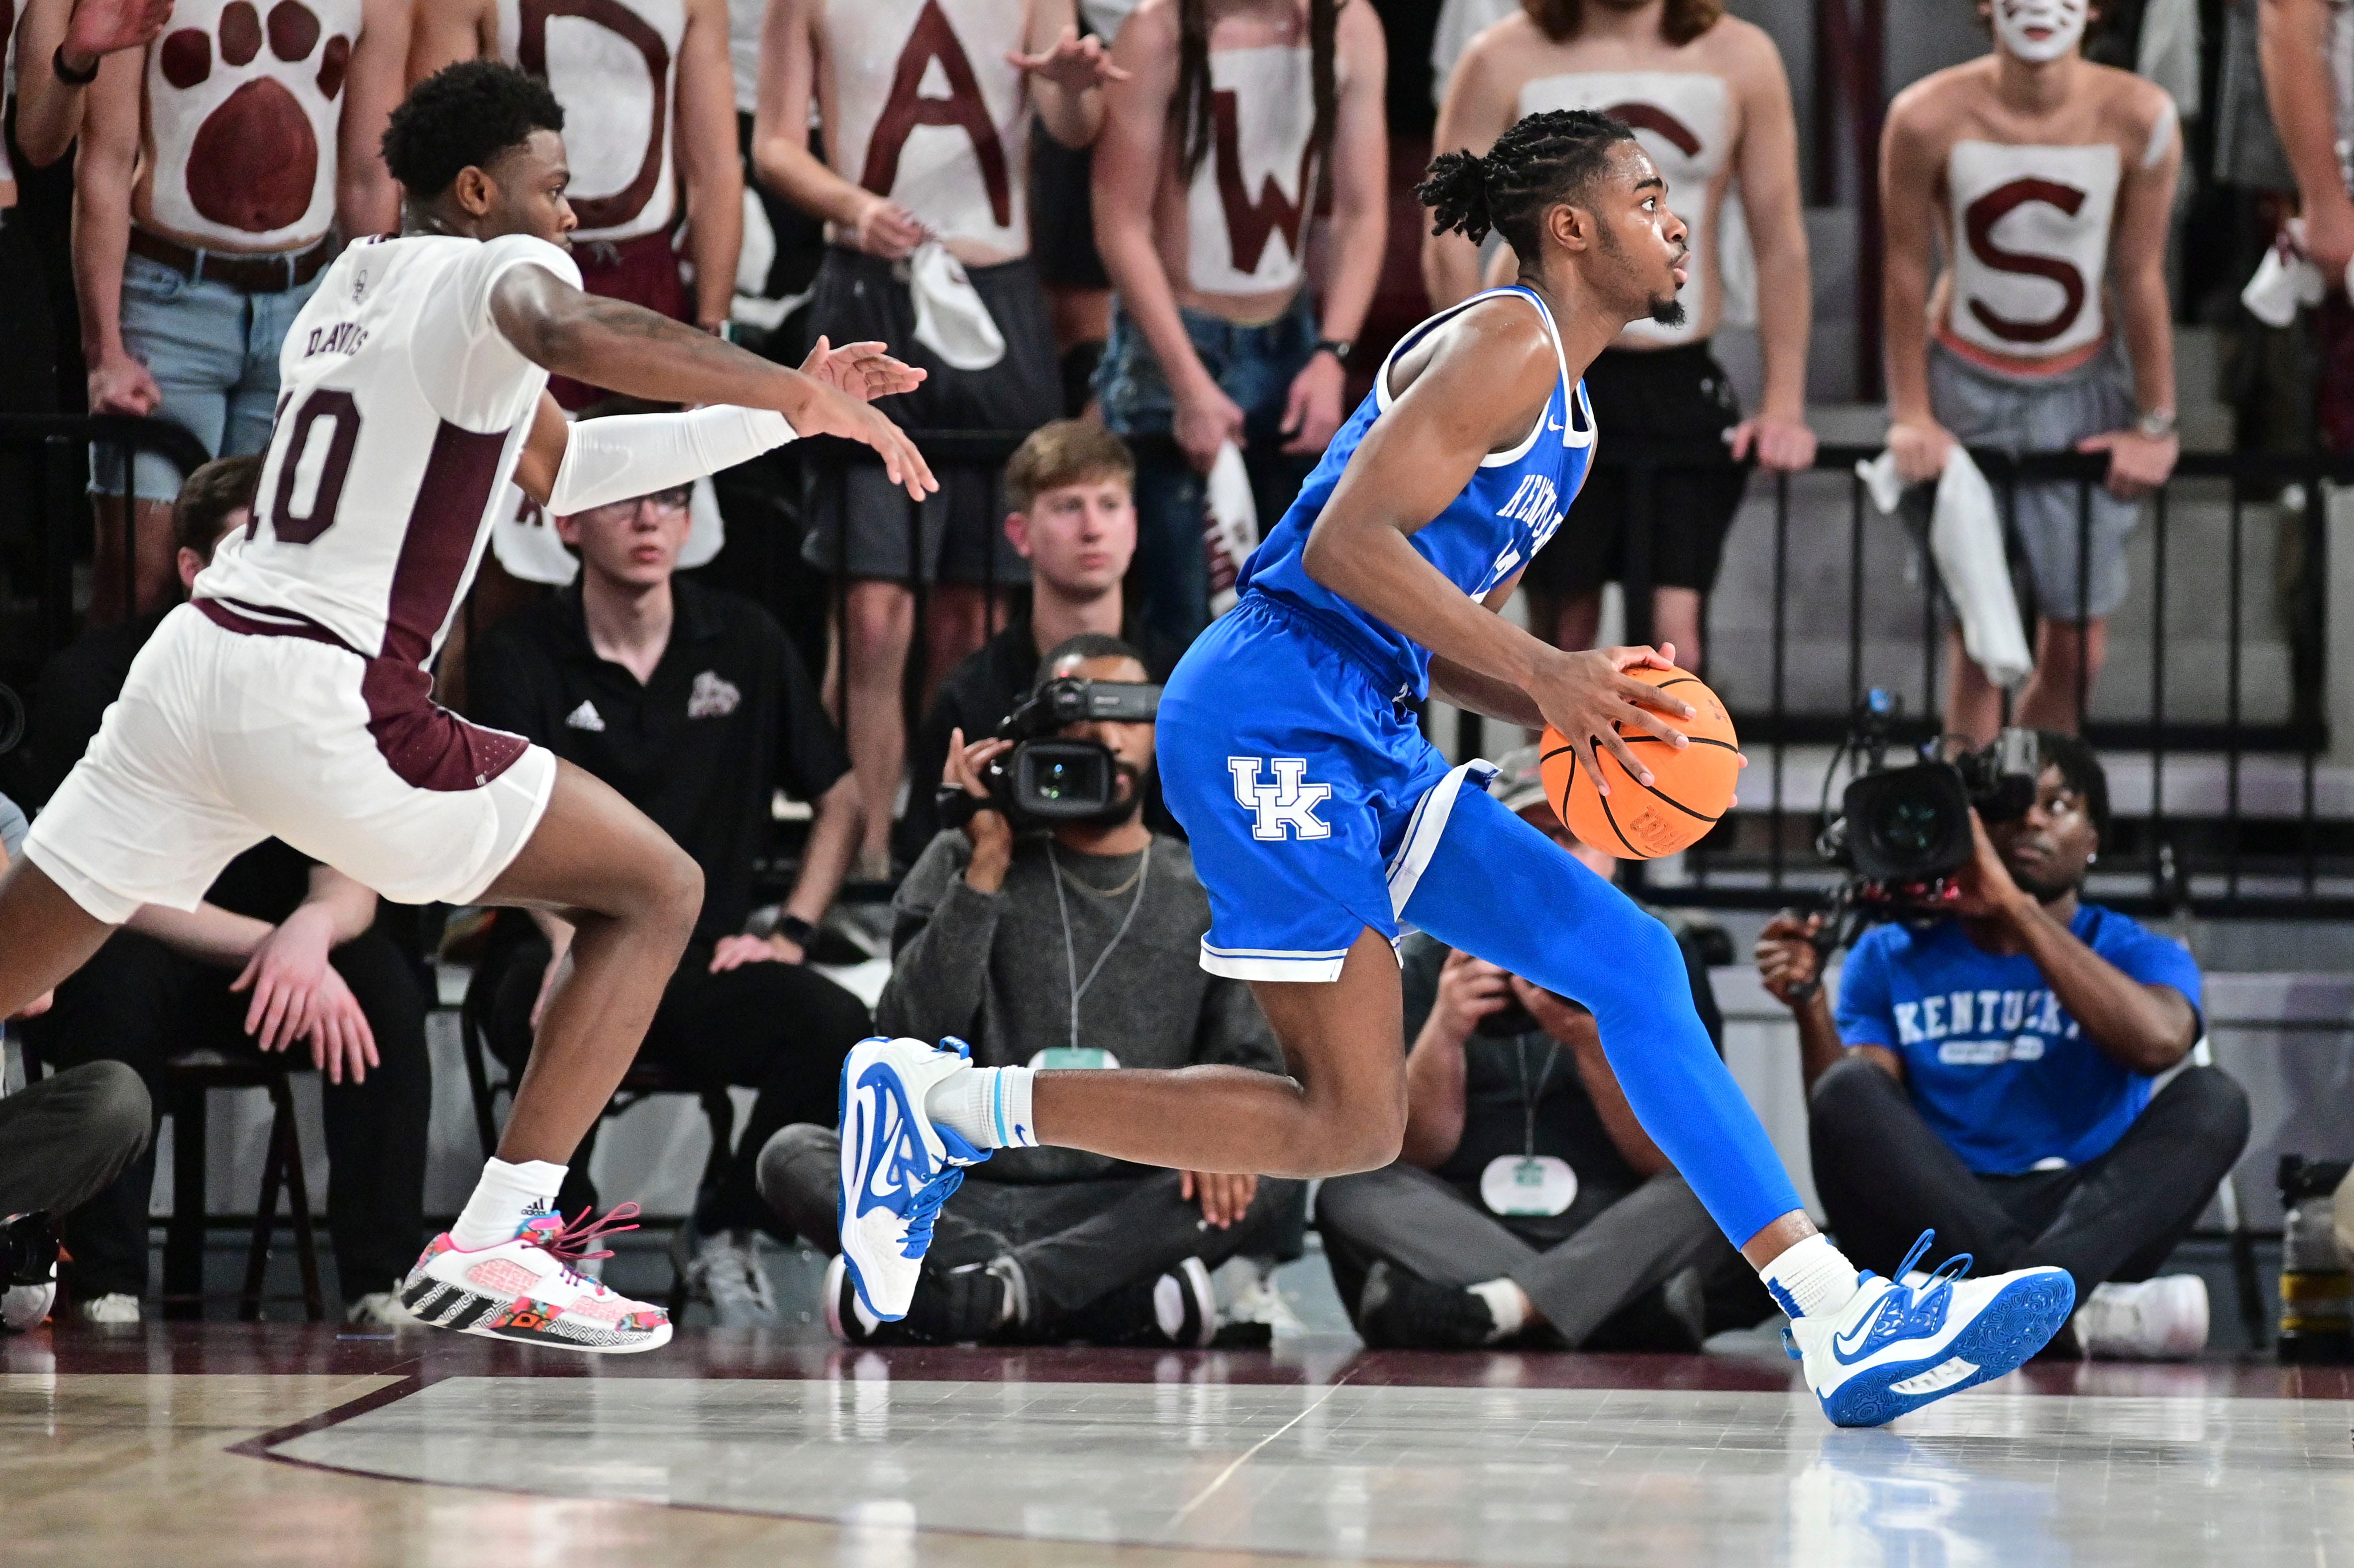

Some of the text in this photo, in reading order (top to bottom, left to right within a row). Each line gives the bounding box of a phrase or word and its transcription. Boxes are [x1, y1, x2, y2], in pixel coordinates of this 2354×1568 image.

[518, 0, 670, 228] D
[862, 0, 1011, 227] A
[1211, 91, 1318, 275] W
[304, 321, 368, 358] DAVIS
[1964, 176, 2085, 343] S
[1228, 756, 1331, 841] UK
